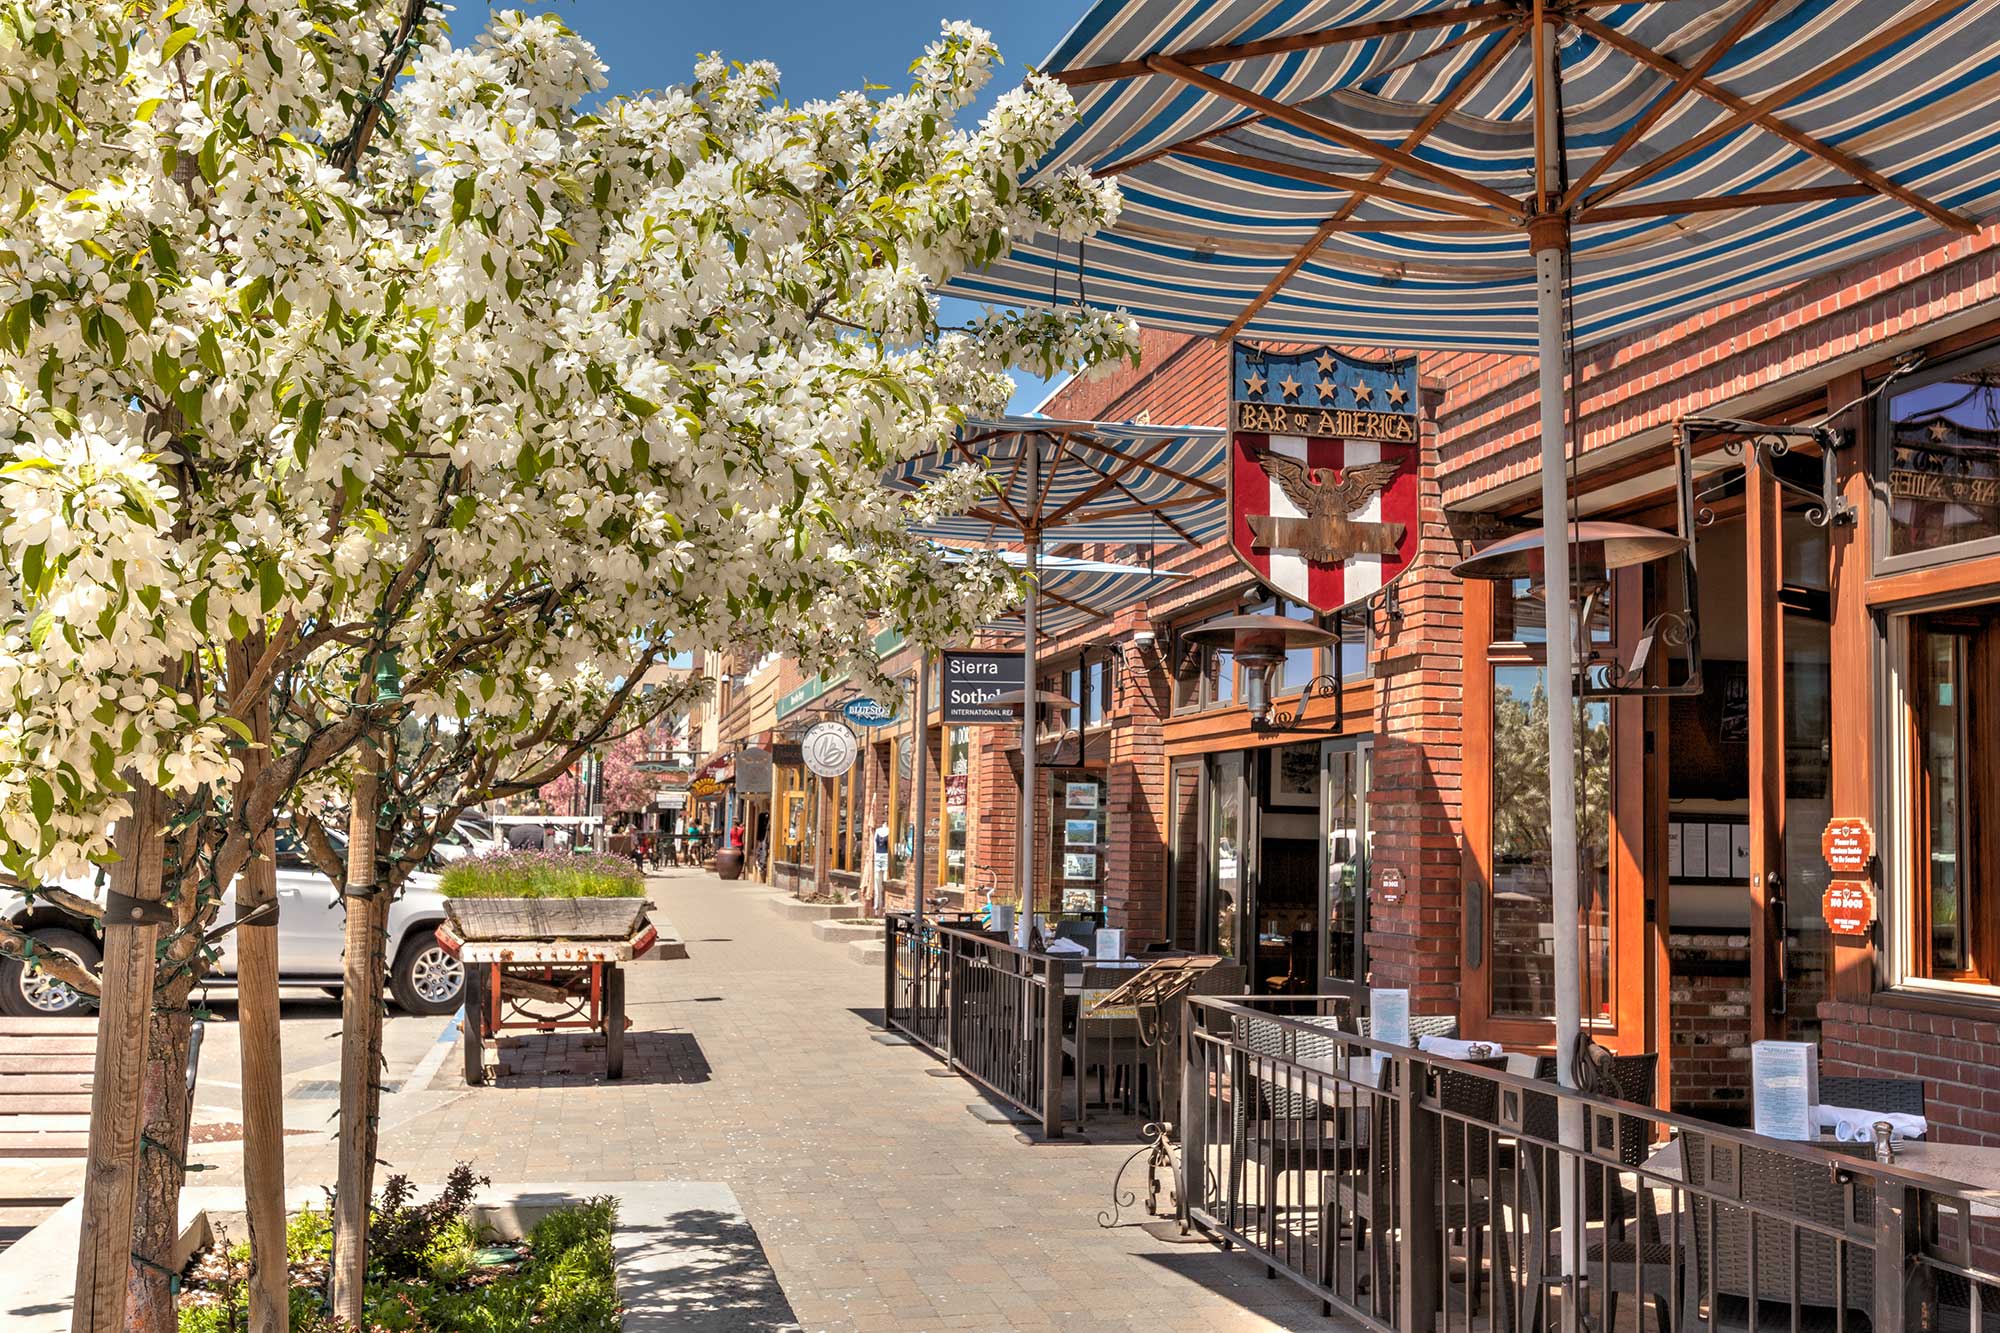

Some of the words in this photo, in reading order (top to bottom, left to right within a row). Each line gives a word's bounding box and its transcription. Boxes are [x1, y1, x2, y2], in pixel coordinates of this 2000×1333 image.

[1243, 404, 1288, 432] BAR
[1295, 413, 1310, 431] OF
[1318, 410, 1413, 440] AMERICA
[950, 659, 998, 675] Sierra
[811, 724, 850, 737] NOMAD
[1830, 898, 1842, 907] NO
[1843, 899, 1863, 908] DOGS
